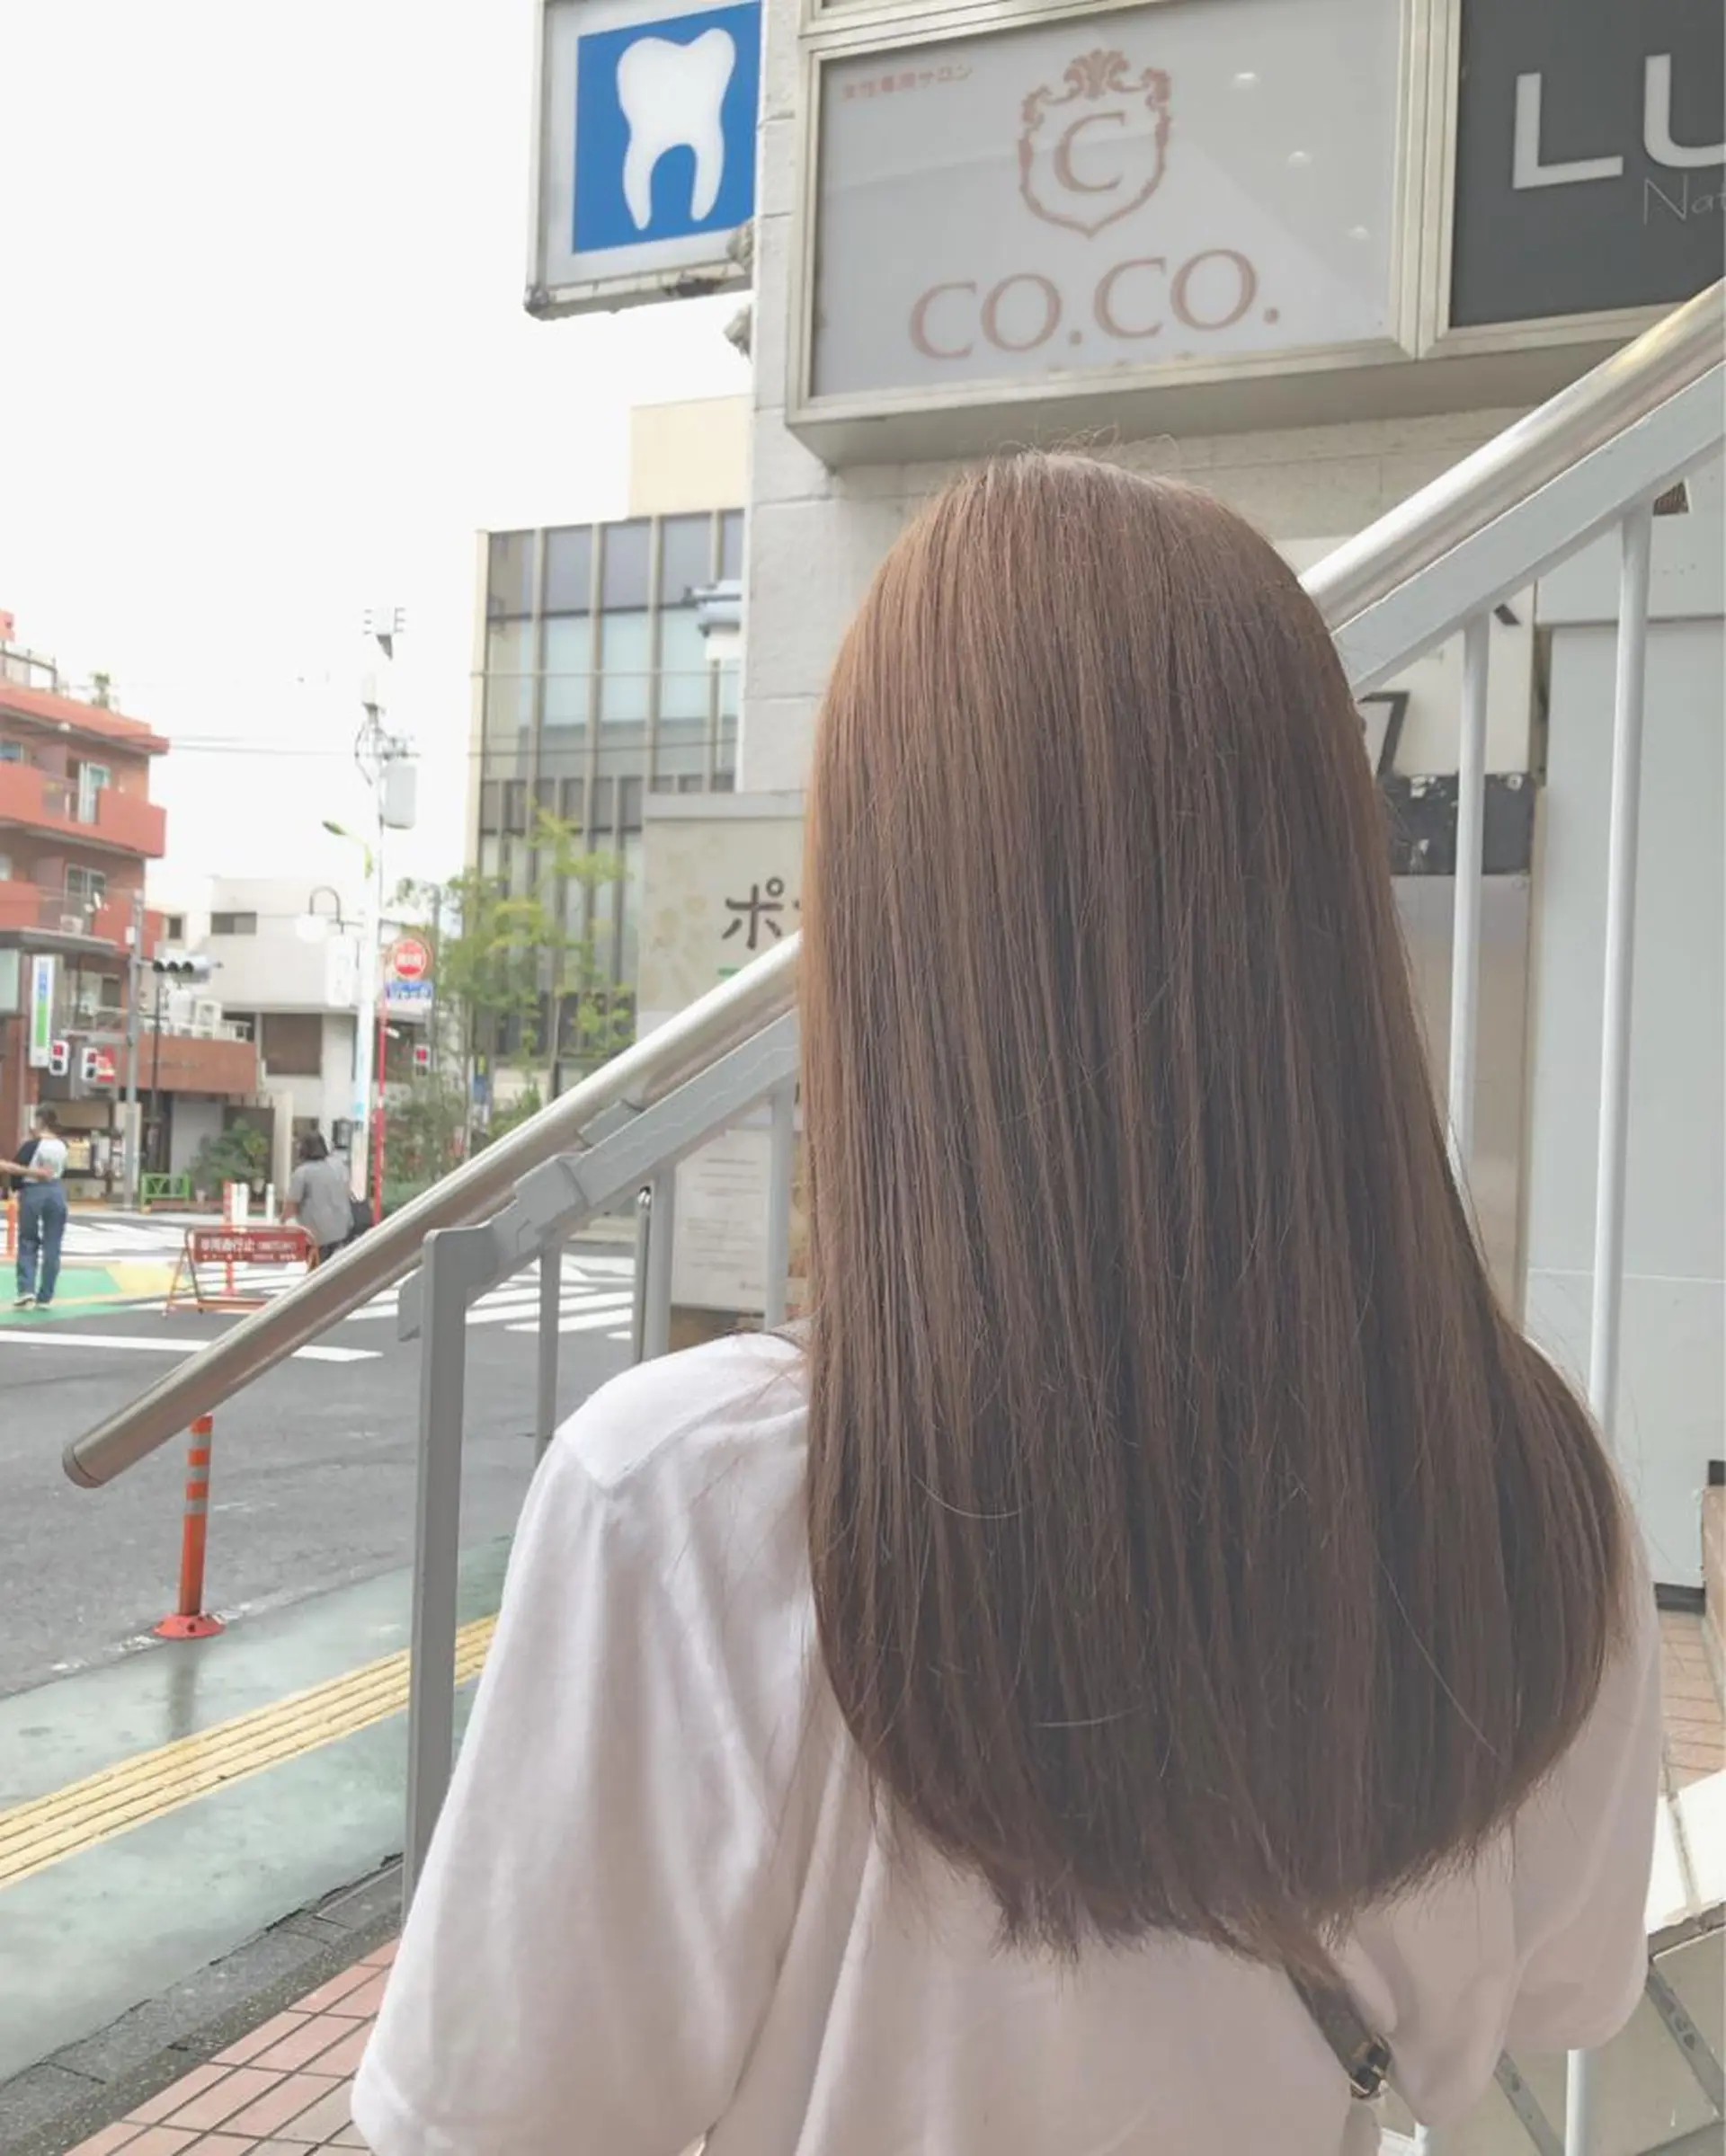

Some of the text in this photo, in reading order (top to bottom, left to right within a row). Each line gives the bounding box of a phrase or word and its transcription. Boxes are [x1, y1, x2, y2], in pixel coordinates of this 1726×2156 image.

[1054, 111, 1125, 194] C
[1512, 53, 1725, 190] LU
[908, 247, 1280, 359] CO.CO.
[721, 875, 801, 951] ポ
